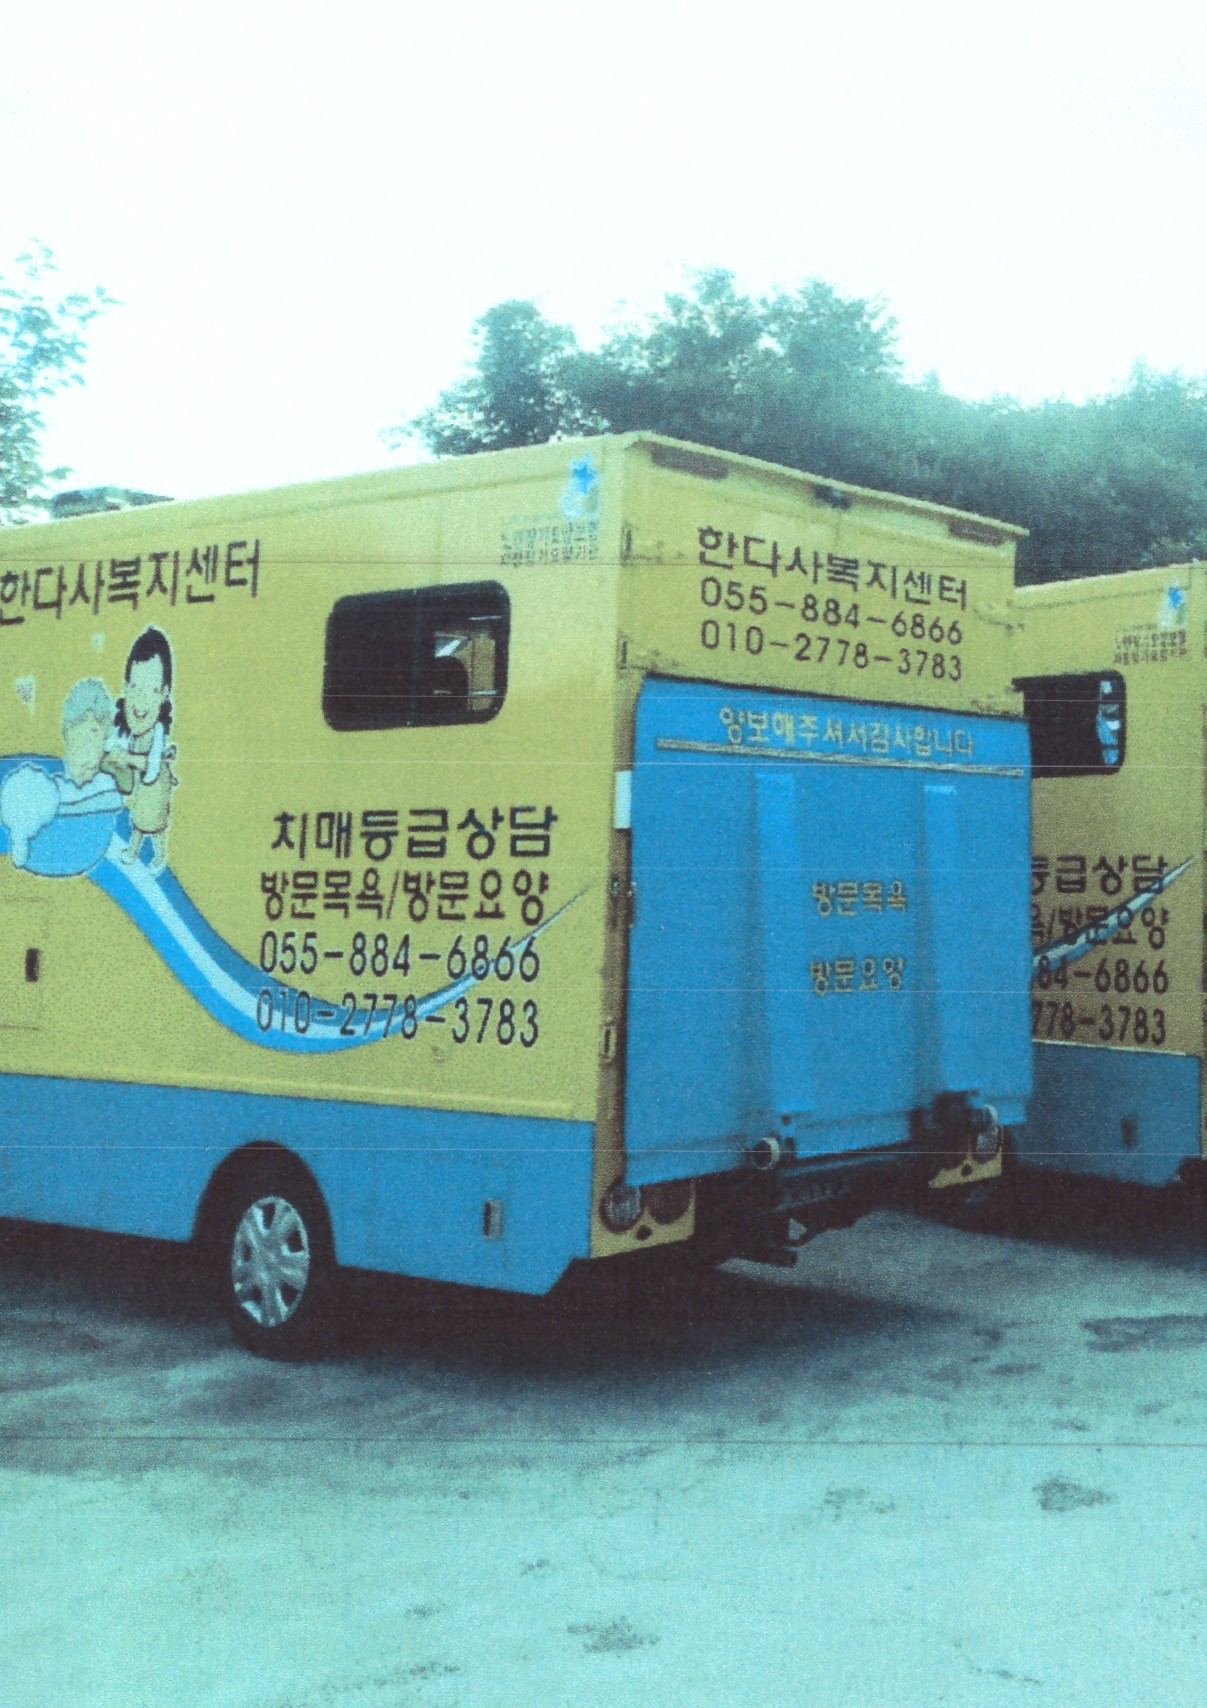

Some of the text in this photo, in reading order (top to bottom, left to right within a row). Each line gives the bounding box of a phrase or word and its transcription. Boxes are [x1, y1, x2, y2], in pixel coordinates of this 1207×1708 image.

[0, 539, 260, 626] 한다사복지센터
[698, 525, 967, 611] 한다사복지센터
[700, 576, 963, 656] 055-884-6866
[700, 619, 962, 682] 010-2778-3783
[271, 806, 558, 861] 치매등급상담
[260, 867, 549, 926] 방문목욕/방문요양
[812, 880, 907, 918] 방문목욕
[259, 930, 540, 983] 055-884-6866
[810, 956, 905, 996] 방문요양
[256, 988, 539, 1048] 010-2778-3783
